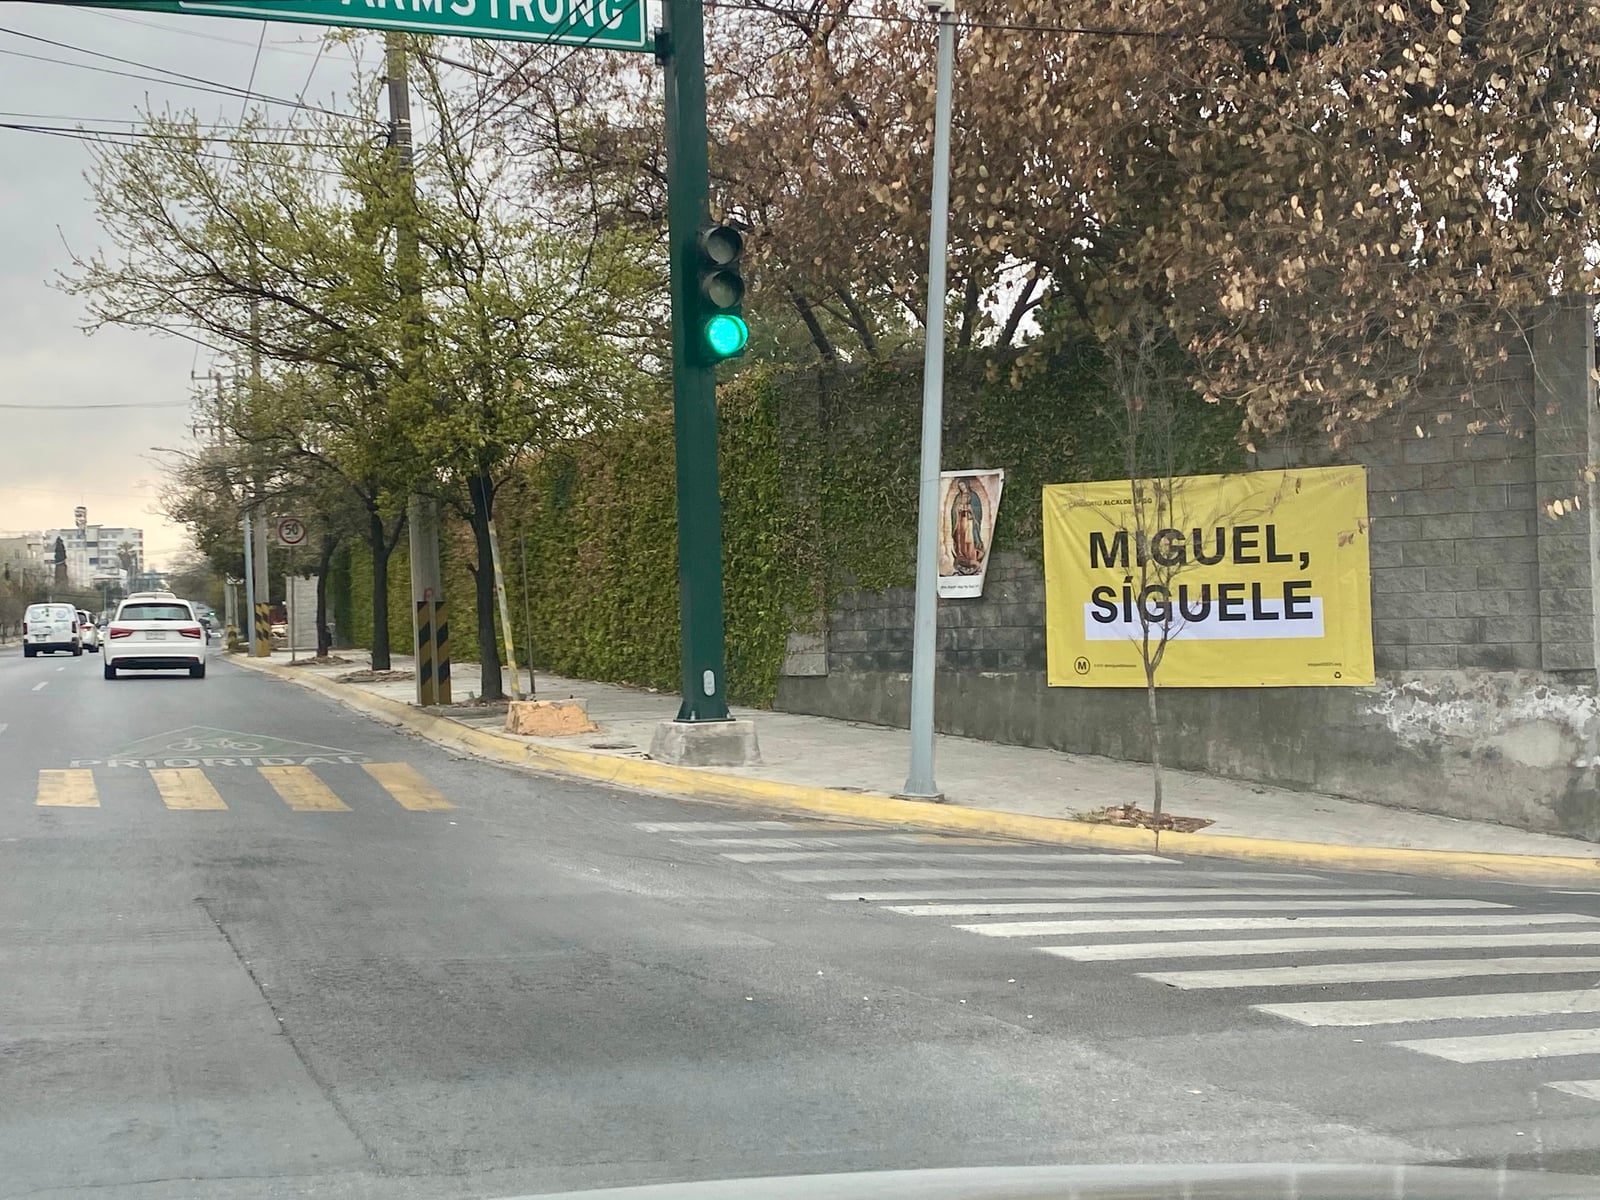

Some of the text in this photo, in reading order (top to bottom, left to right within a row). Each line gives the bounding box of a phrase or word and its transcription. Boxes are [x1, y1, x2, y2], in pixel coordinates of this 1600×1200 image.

[340, 0, 624, 29] TRONG
[285, 523, 298, 535] 50
[1089, 524, 1310, 570] MIGUEL,
[1091, 575, 1313, 623] SÍGUELE
